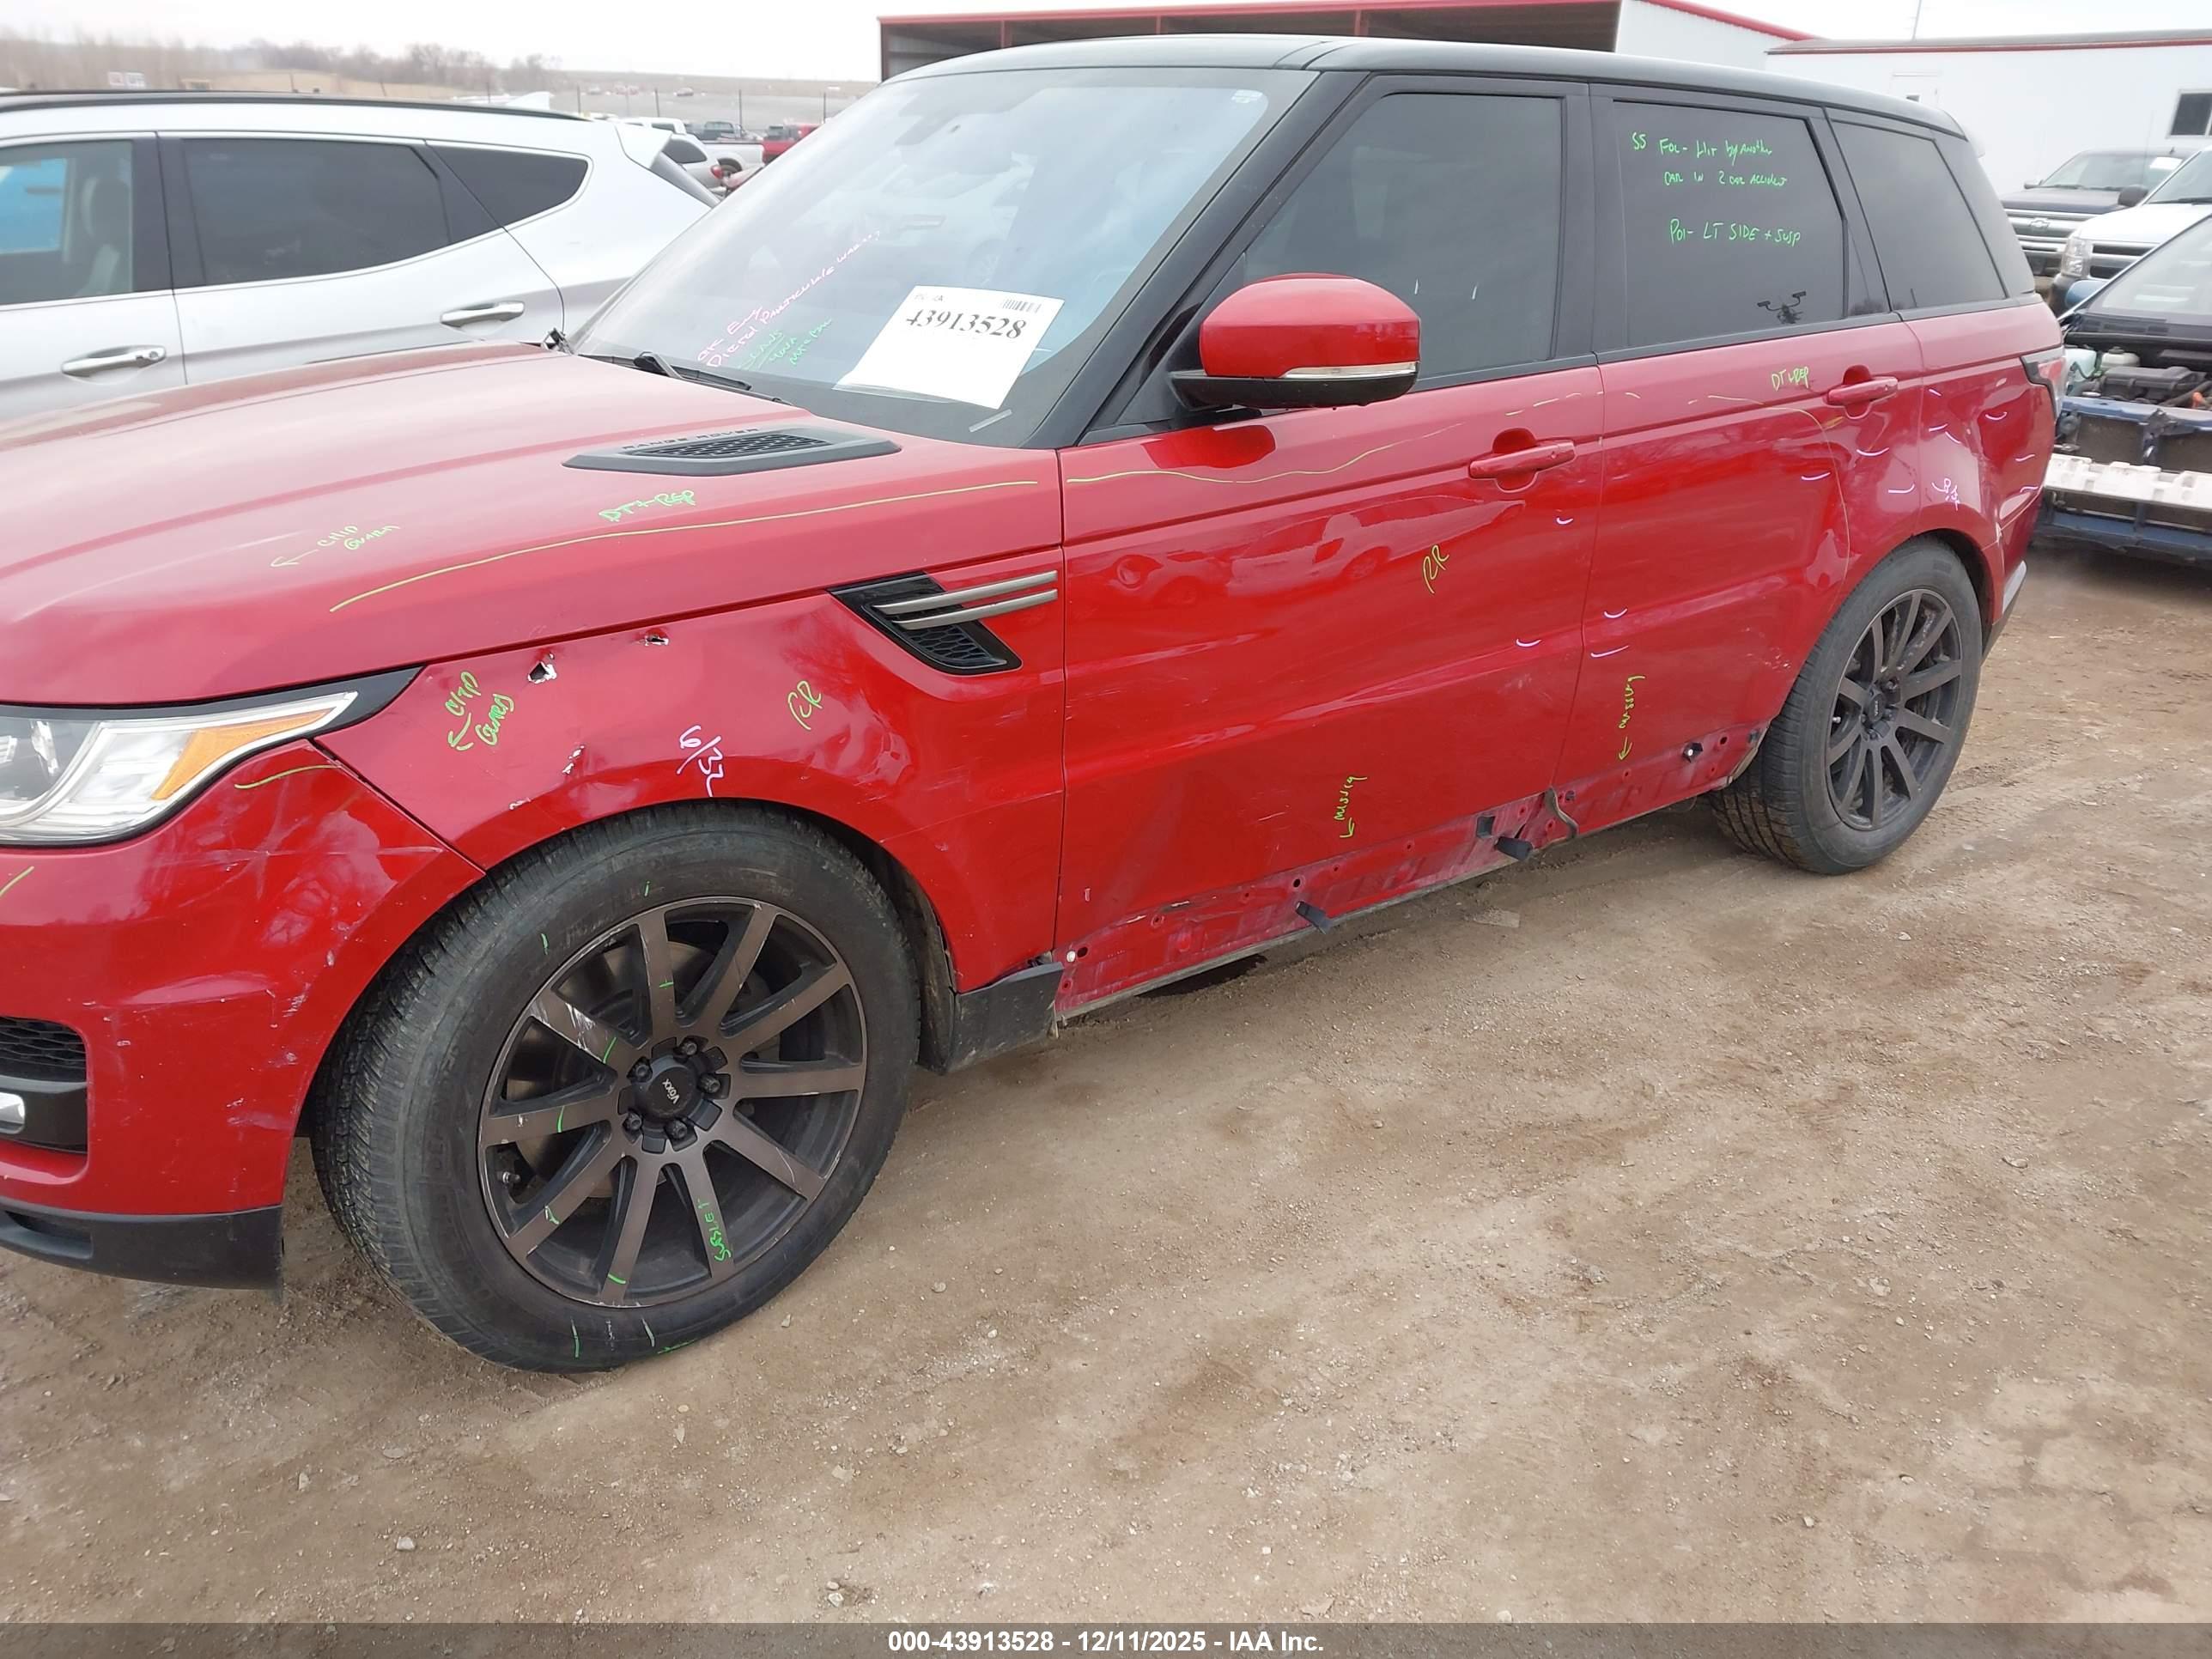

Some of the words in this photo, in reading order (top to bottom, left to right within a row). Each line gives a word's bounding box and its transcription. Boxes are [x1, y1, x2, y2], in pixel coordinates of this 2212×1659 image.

[1704, 222, 1724, 240] LT
[1729, 223, 1759, 241] SIDE
[906, 309, 1027, 339] 43913528
